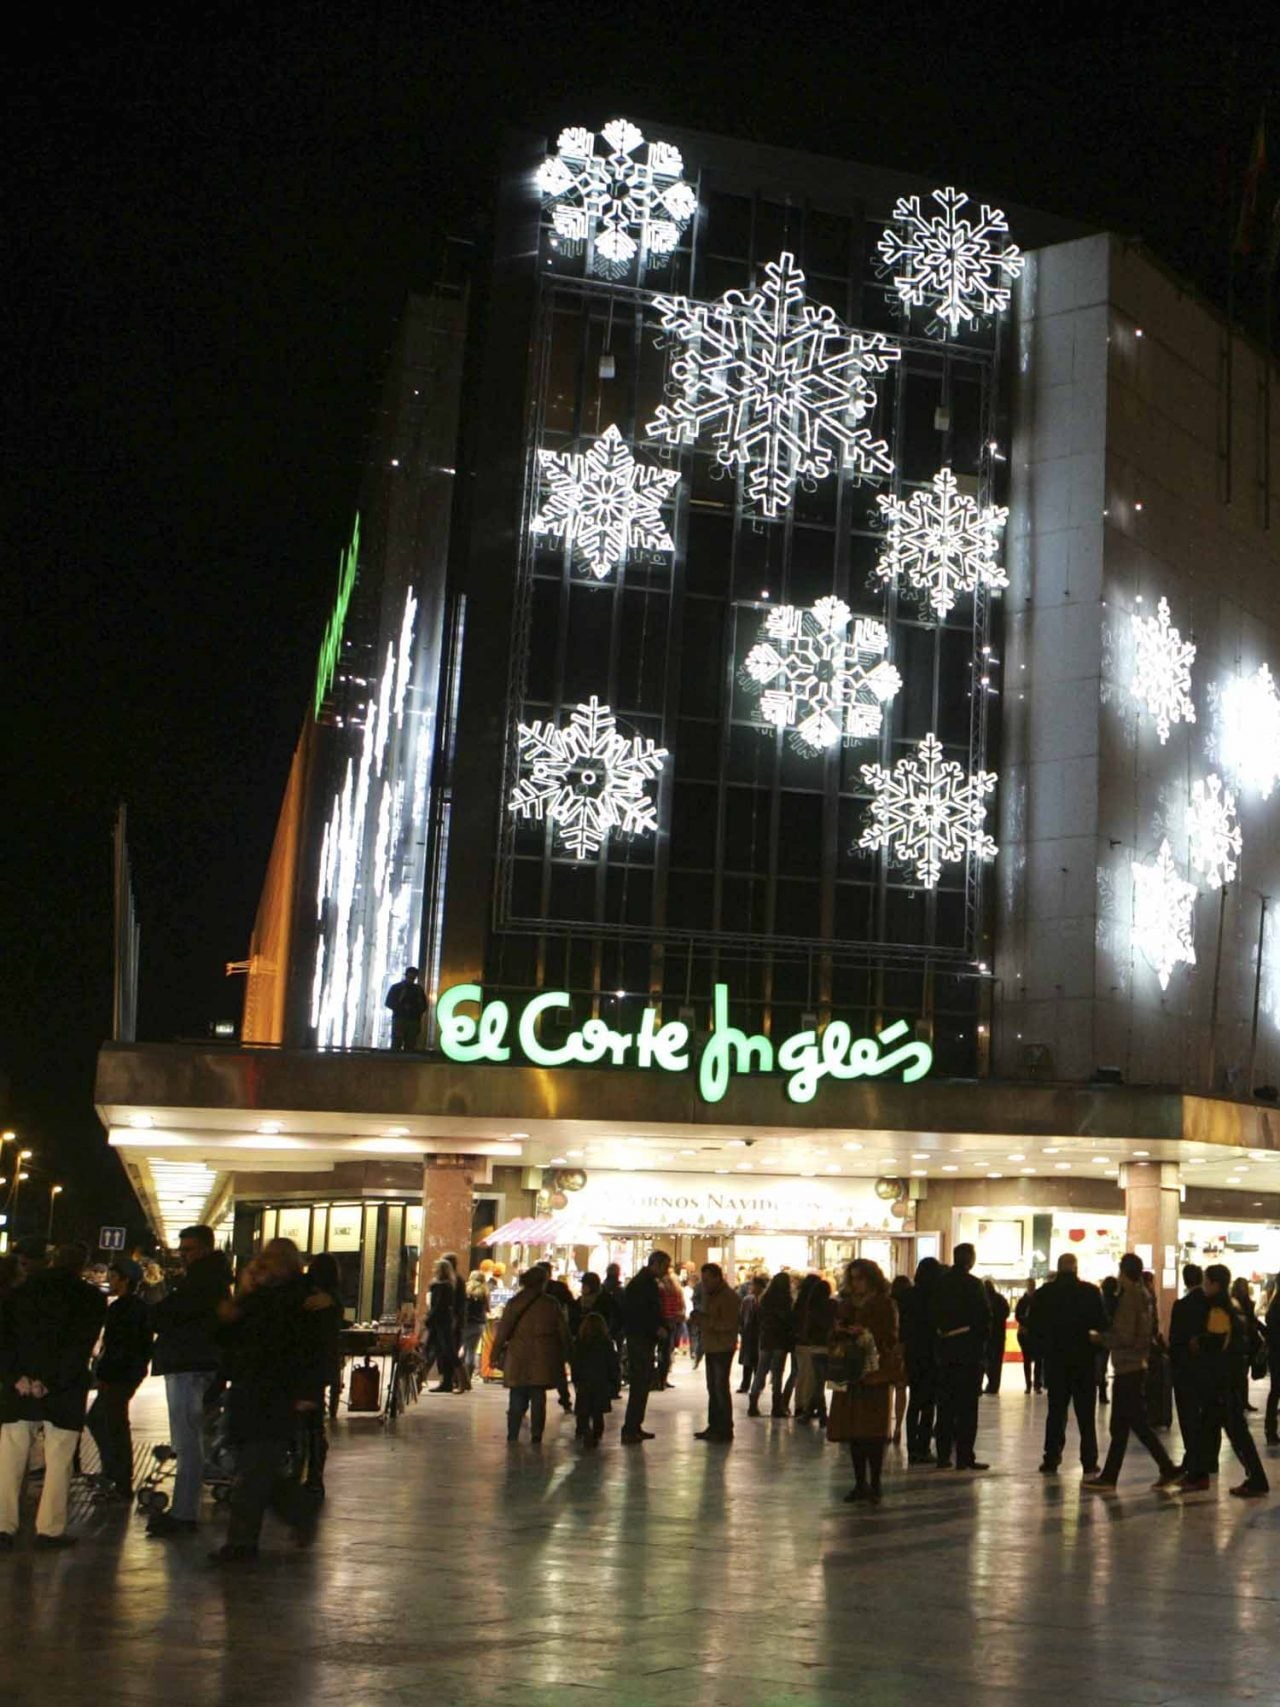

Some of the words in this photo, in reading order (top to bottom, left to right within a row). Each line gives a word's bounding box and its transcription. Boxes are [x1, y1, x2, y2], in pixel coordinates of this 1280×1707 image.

[437, 983, 511, 1063] El
[518, 991, 689, 1072] Corte
[699, 983, 934, 1103] Inglés
